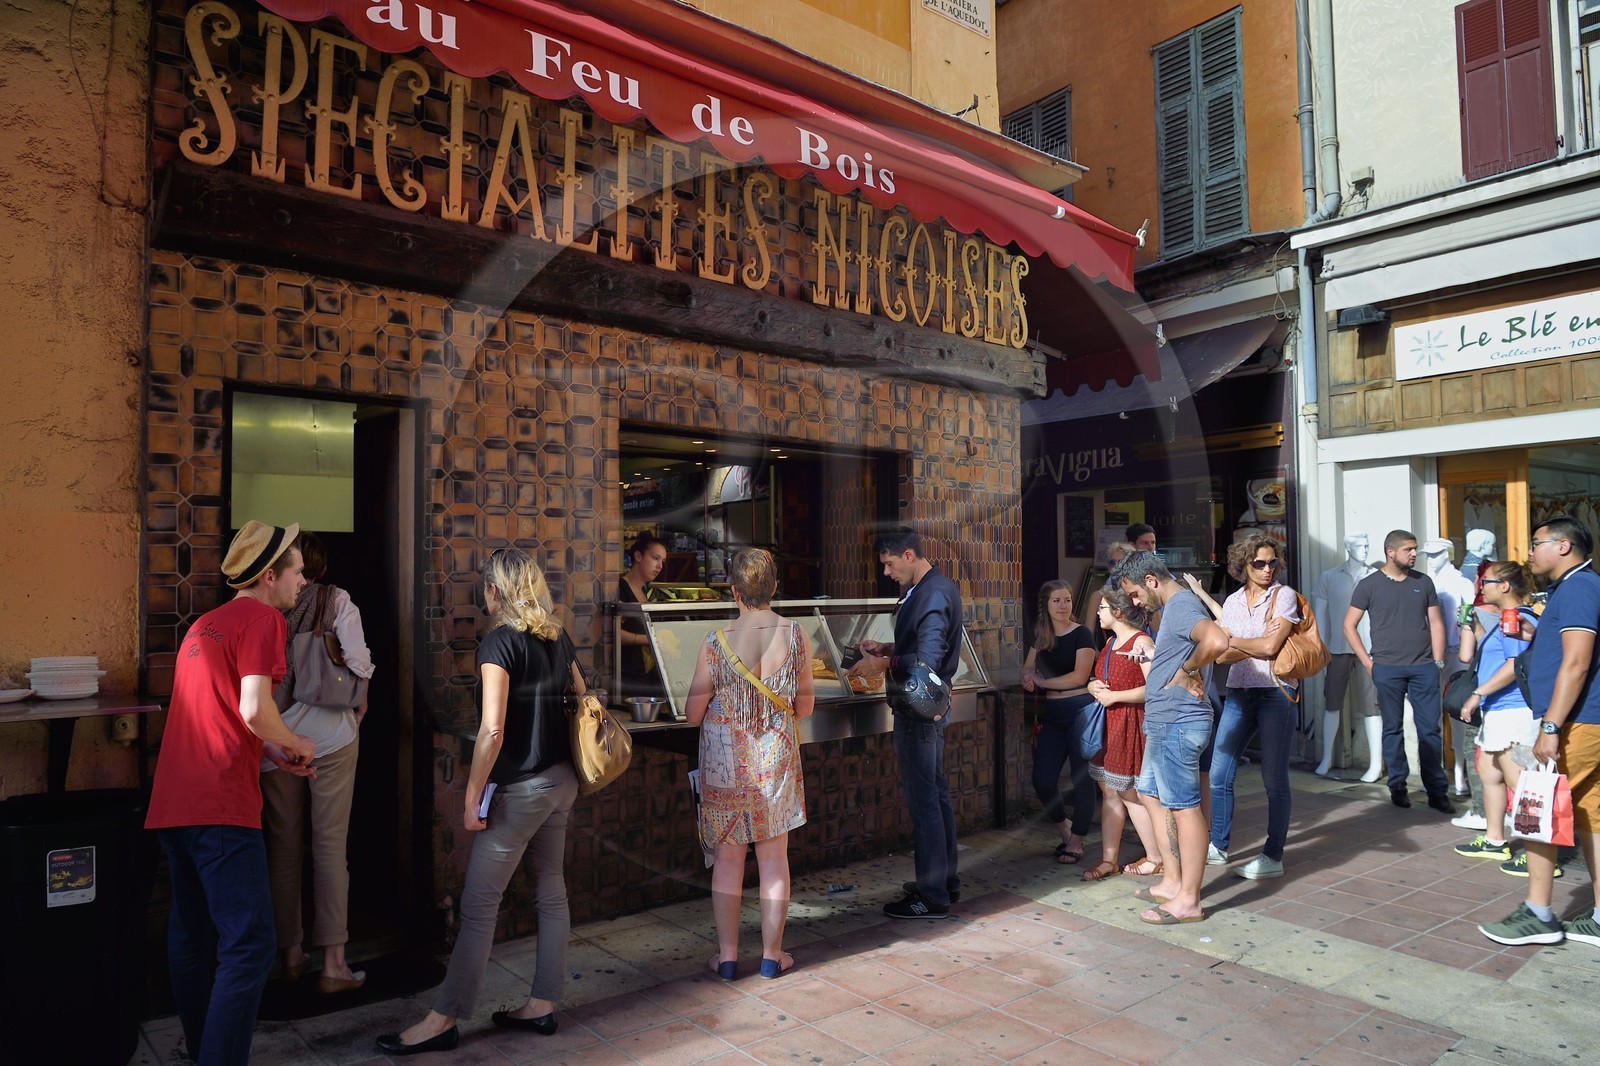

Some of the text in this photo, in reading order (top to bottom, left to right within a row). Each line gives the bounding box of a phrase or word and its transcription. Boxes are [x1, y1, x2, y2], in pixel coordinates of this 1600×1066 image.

[941, 1, 986, 30] L'AQUEDOT
[366, 0, 896, 195] au Feu de Bois
[178, 0, 1030, 349] SPECIALITES NICOISES
[1457, 310, 1600, 352] Le Blé en
[1490, 345, 1562, 361] Collection
